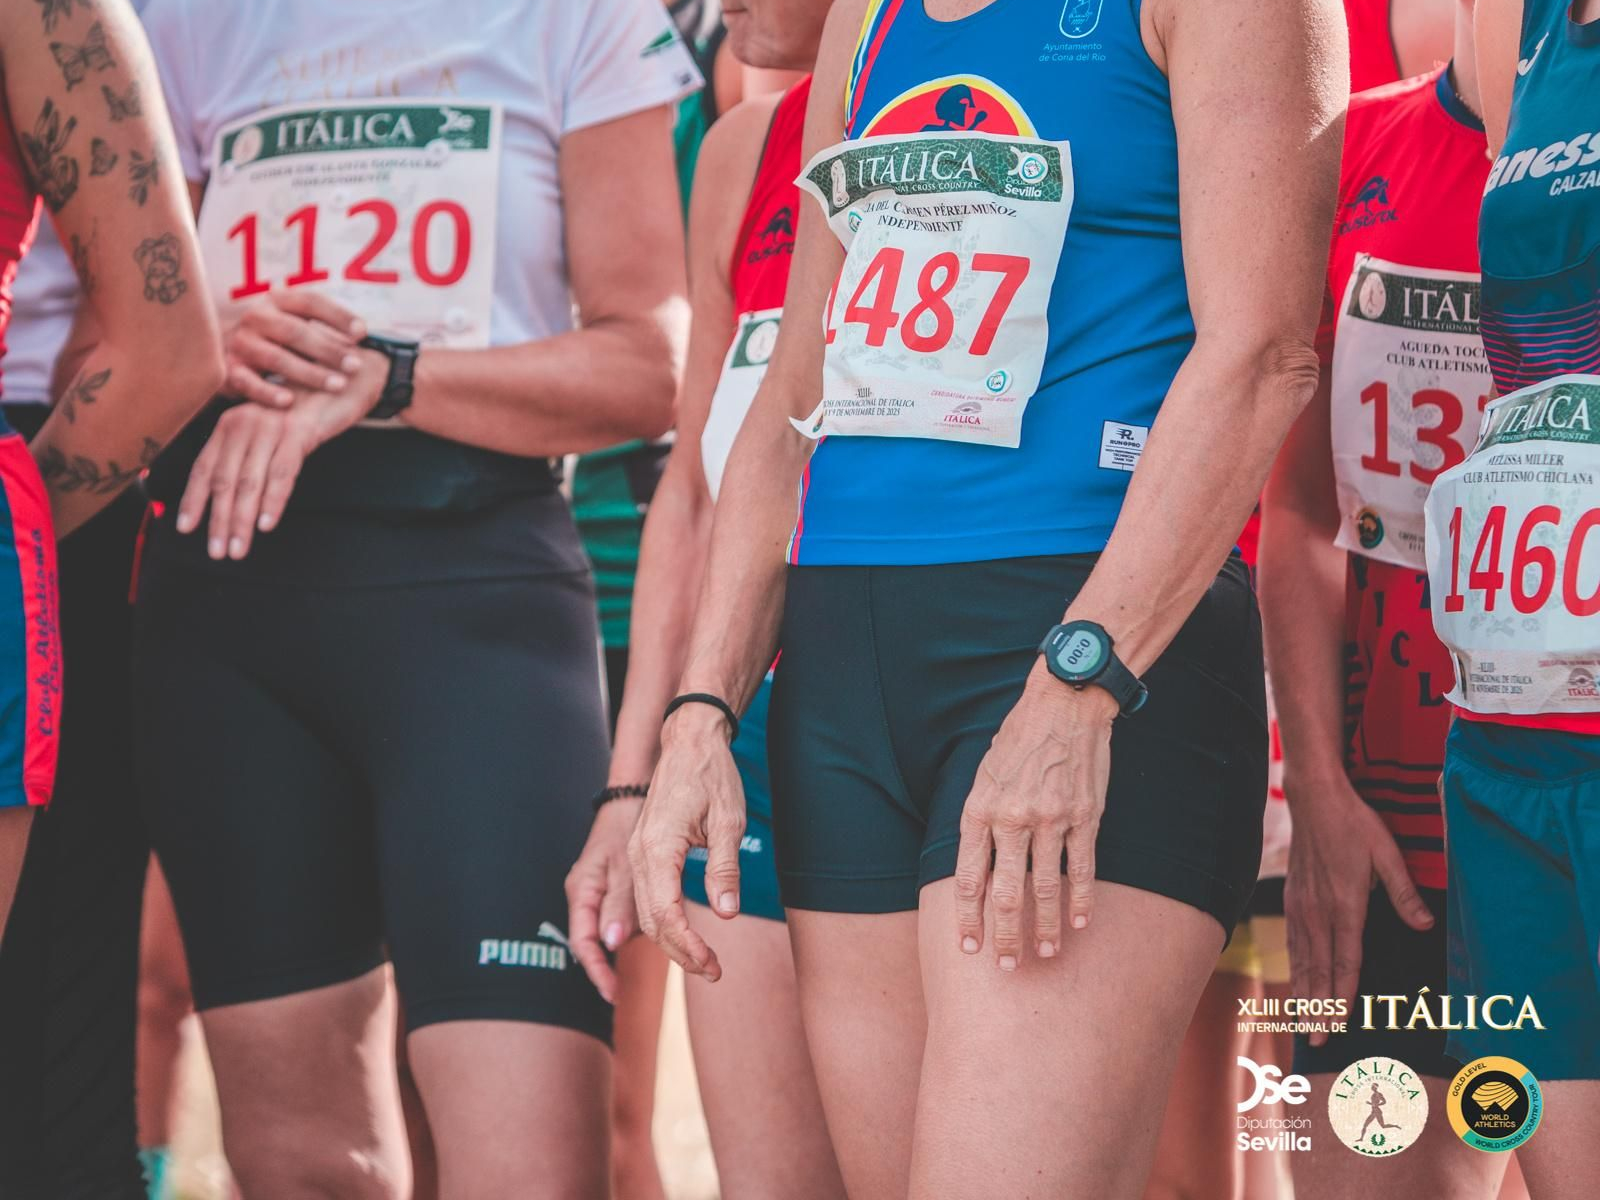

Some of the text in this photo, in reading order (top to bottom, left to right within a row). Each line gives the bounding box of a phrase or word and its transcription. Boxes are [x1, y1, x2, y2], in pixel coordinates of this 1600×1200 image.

[858, 146, 981, 189] ITÁLICA
[911, 183, 936, 192] CROSS
[938, 181, 980, 191] COUNTRY
[1004, 184, 1042, 198] Sevilla
[933, 202, 971, 217] PÉREZ
[972, 201, 1018, 218] MUÑOZ
[878, 215, 964, 233] INDEPENDIENTE
[226, 198, 473, 301] 1120
[1399, 340, 1450, 356] AGUEDA
[1386, 352, 1416, 368] CLUB
[878, 398, 887, 407] DE
[943, 415, 981, 425] ITALICA
[1550, 430, 1591, 441] COUNTRY
[1525, 453, 1565, 467] MILLER
[1463, 471, 1593, 485] CLUB ATLETISMO CHICLANA
[36, 672, 53, 737] Club
[478, 938, 566, 971] PUMA
